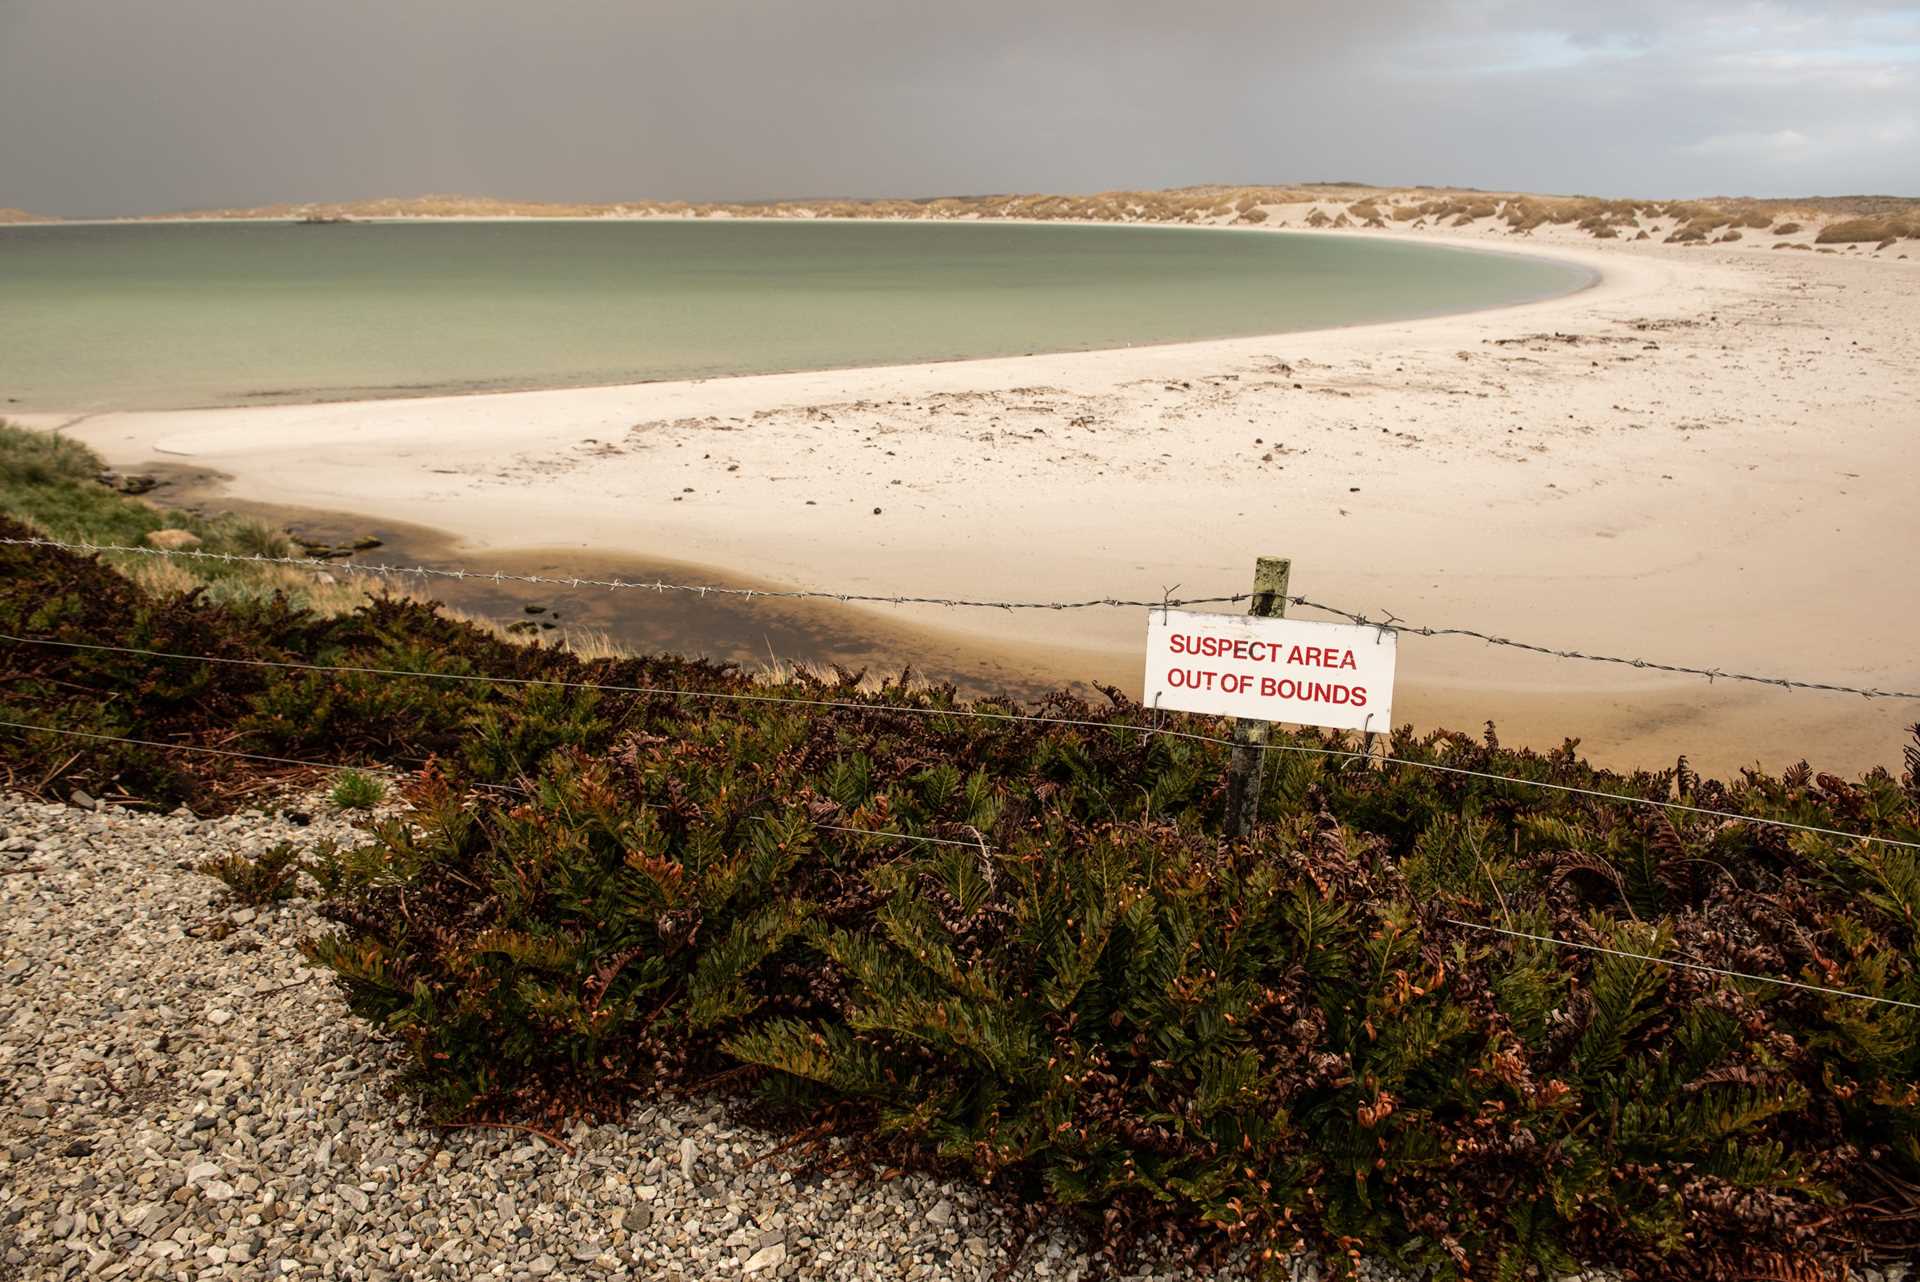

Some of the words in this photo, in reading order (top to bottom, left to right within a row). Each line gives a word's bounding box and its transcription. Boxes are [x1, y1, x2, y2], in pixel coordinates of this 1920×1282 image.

[1169, 633, 1282, 663] SUSPECT
[1287, 645, 1357, 670] AREA
[1167, 668, 1217, 690] OUT
[1220, 673, 1254, 694] OF
[1260, 677, 1368, 707] BOUNDS
